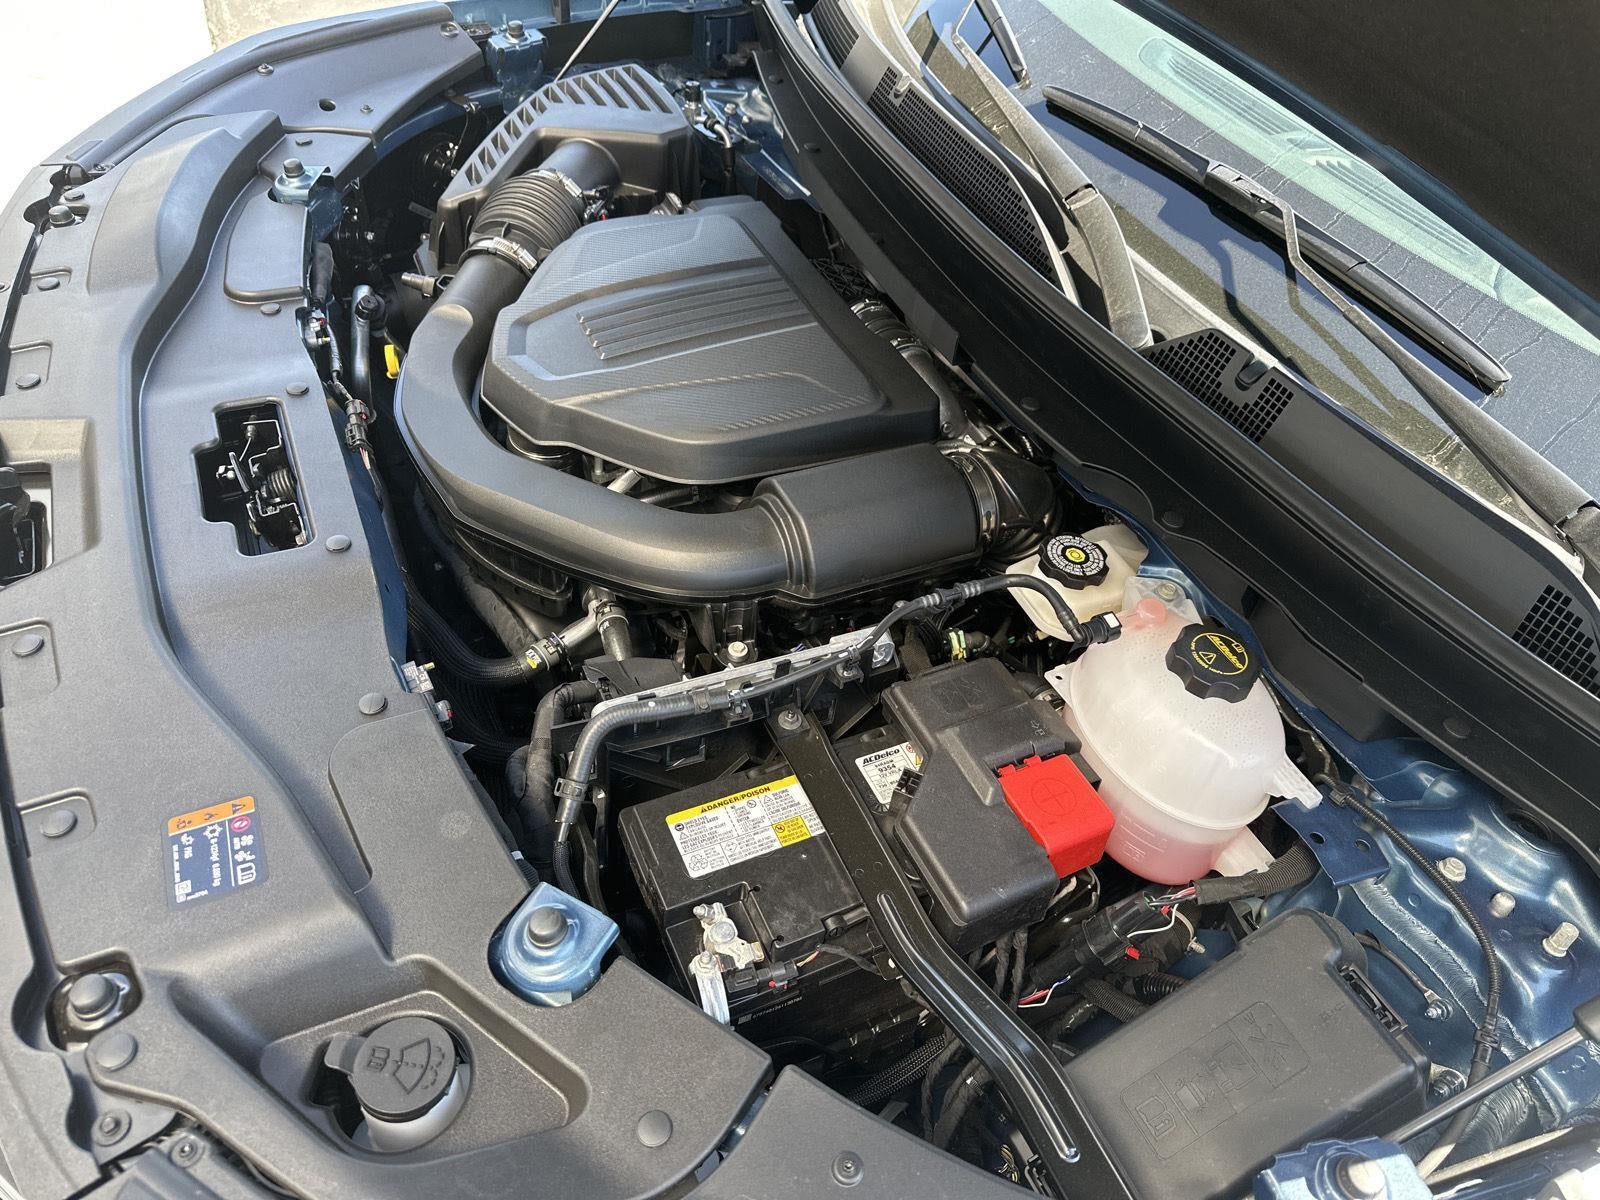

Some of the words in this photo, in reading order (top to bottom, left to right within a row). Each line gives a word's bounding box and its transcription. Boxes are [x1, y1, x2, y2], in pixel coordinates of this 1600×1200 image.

[1209, 635, 1244, 669] ACDelco
[863, 749, 900, 764] ACDelco
[878, 764, 896, 772] 9354
[708, 786, 771, 810] DANGER/POISON
